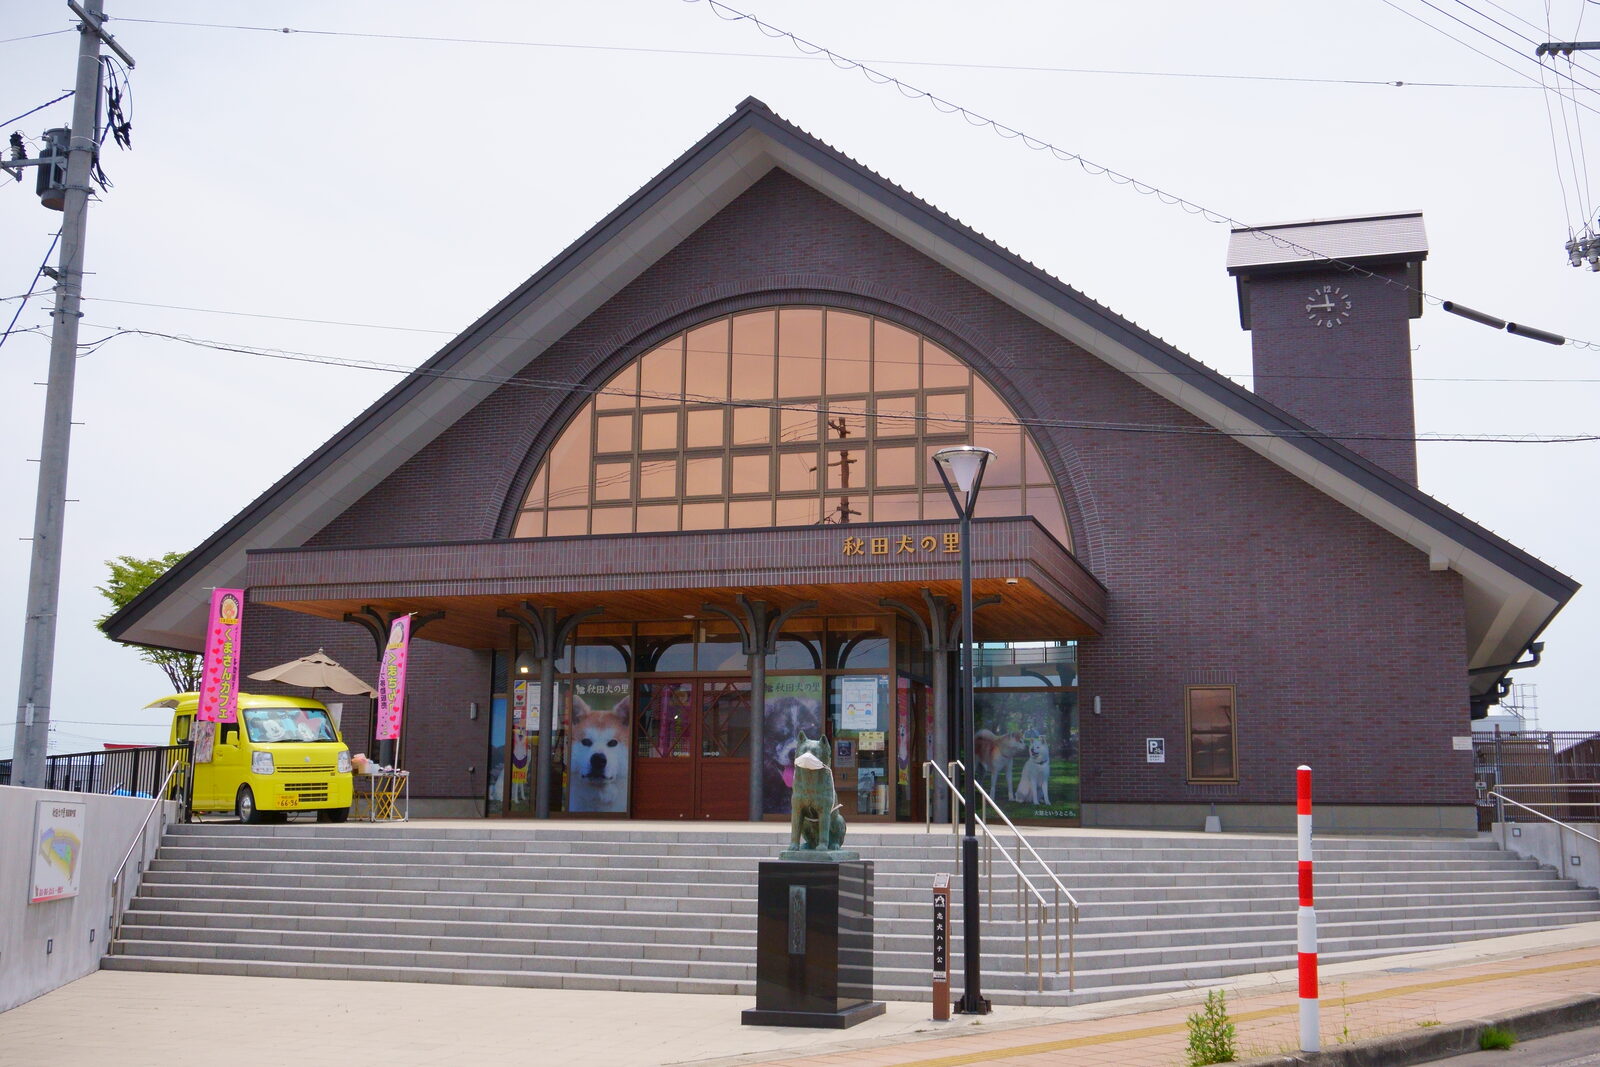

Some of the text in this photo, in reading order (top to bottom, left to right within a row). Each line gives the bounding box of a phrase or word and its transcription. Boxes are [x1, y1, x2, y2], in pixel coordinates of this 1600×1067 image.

[1323, 285, 1331, 293] 12
[1345, 301, 1351, 309] 3
[1326, 320, 1332, 328] 6
[843, 532, 960, 556] 秋田犬の里
[218, 627, 233, 719] くまさんカフェ
[586, 683, 629, 694] 秋田犬の里
[776, 682, 820, 693] 秋田犬の里
[1149, 741, 1158, 753] P
[936, 911, 944, 964] 忠犬ハチ公
